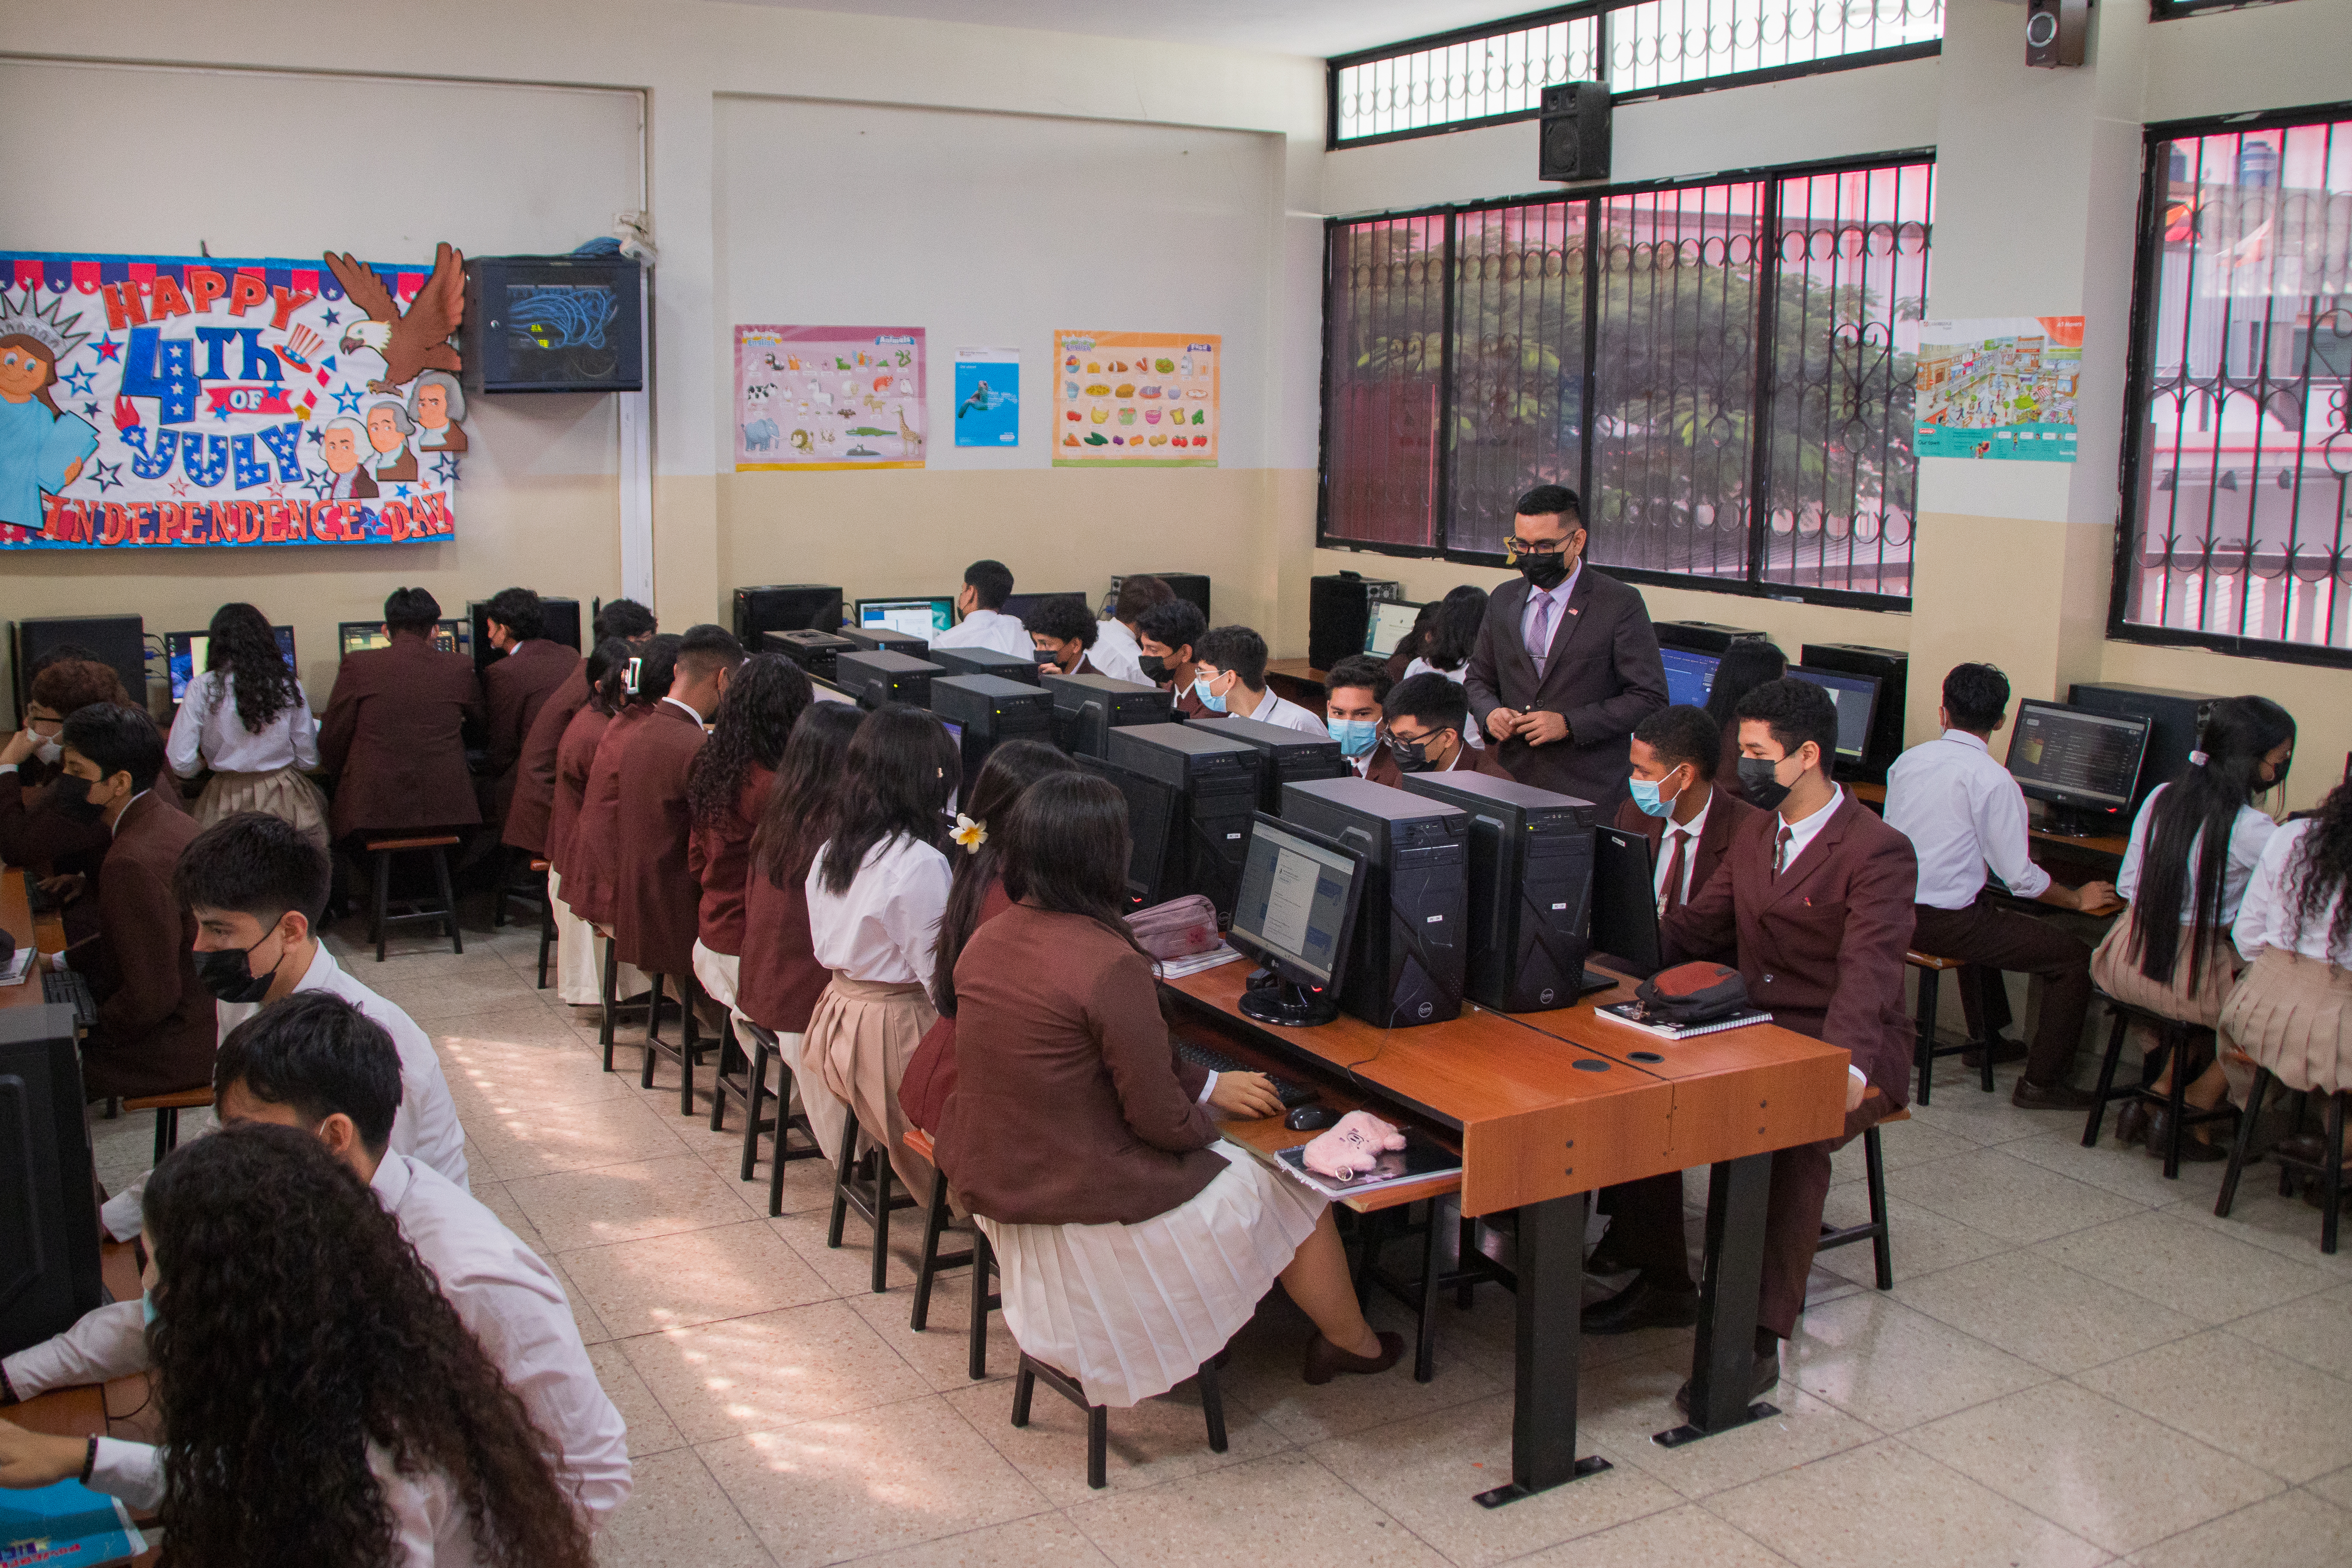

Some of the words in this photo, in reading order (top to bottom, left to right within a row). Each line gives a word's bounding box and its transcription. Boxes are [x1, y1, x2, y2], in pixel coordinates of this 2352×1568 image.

[101, 270, 315, 331] HAPPY
[747, 338, 776, 347] English
[1066, 343, 1091, 352] English
[229, 388, 264, 410] OF
[131, 421, 305, 490] JULY
[36, 493, 366, 546] INDEPENDENCE
[384, 490, 453, 542] DAY
